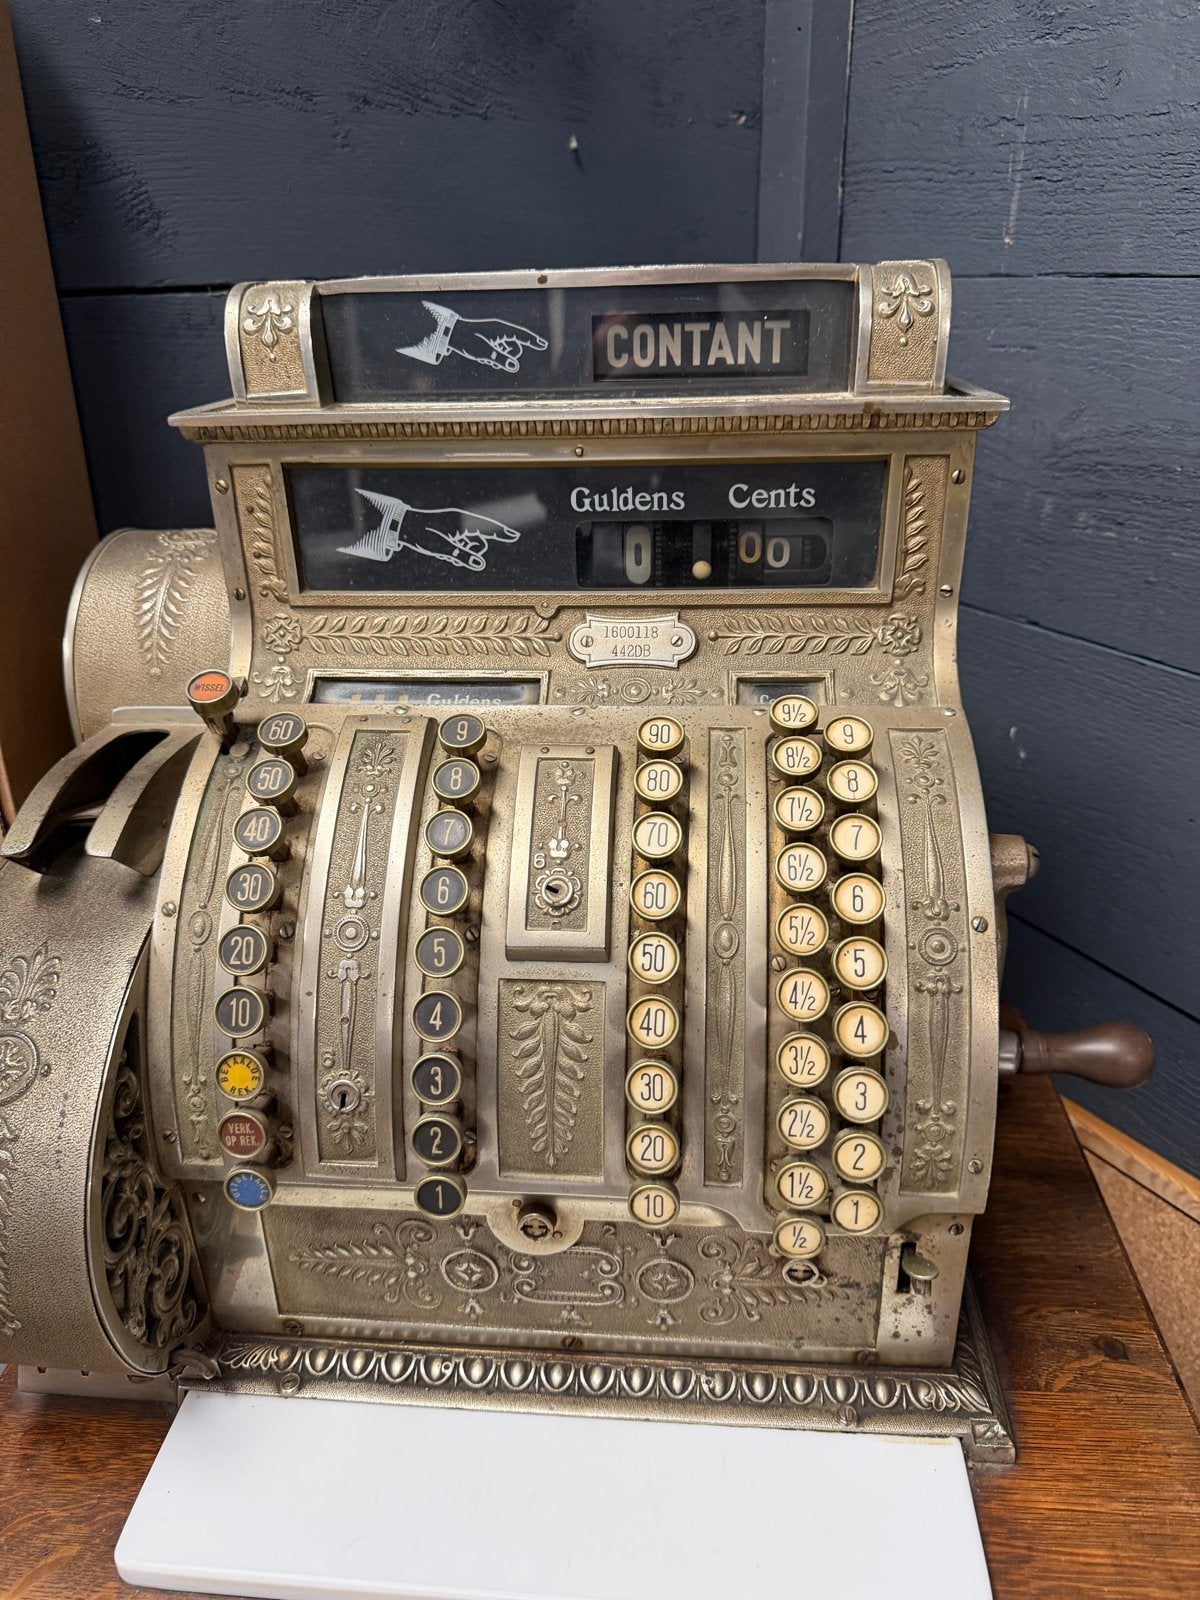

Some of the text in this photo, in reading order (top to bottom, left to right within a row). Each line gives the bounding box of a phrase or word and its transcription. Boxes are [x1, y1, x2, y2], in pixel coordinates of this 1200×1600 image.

[606, 319, 791, 368] CONTANT
[570, 483, 816, 512] Guldens Cents
[604, 626, 659, 638] 1600118
[611, 645, 651, 657] 442DB
[194, 683, 225, 692] WISSEL
[268, 720, 293, 740] 60
[456, 721, 468, 741] 9
[649, 724, 670, 744] 90
[843, 724, 854, 744] 9
[257, 767, 282, 790] 50
[450, 767, 462, 790] 8
[647, 770, 670, 792] 80
[847, 770, 858, 792] 8
[244, 816, 269, 841] 40
[443, 819, 455, 846] 7
[647, 822, 668, 847] 70
[851, 825, 864, 850] 7
[237, 874, 261, 901] 30
[438, 877, 449, 904] 6
[643, 882, 667, 910] 60
[852, 885, 864, 912] 6
[230, 936, 254, 965] 20
[434, 938, 445, 967] 5
[642, 944, 665, 972] 50
[853, 948, 865, 978] 5
[230, 998, 250, 1026] 10
[429, 1002, 442, 1031] 4
[639, 1008, 665, 1038] 40
[854, 1015, 867, 1044] 4
[220, 1057, 260, 1083] BETAALDE
[431, 1066, 442, 1095] 3
[640, 1073, 663, 1102] 30
[855, 1081, 867, 1110] 3
[226, 1135, 260, 1147] OP REK.
[228, 1123, 255, 1134] VERK.
[430, 1127, 443, 1155] 2
[641, 1135, 664, 1162] 20
[852, 1143, 865, 1171] 2
[435, 1185, 443, 1209] 1
[644, 1194, 664, 1218] 10
[851, 1200, 859, 1225] 1
